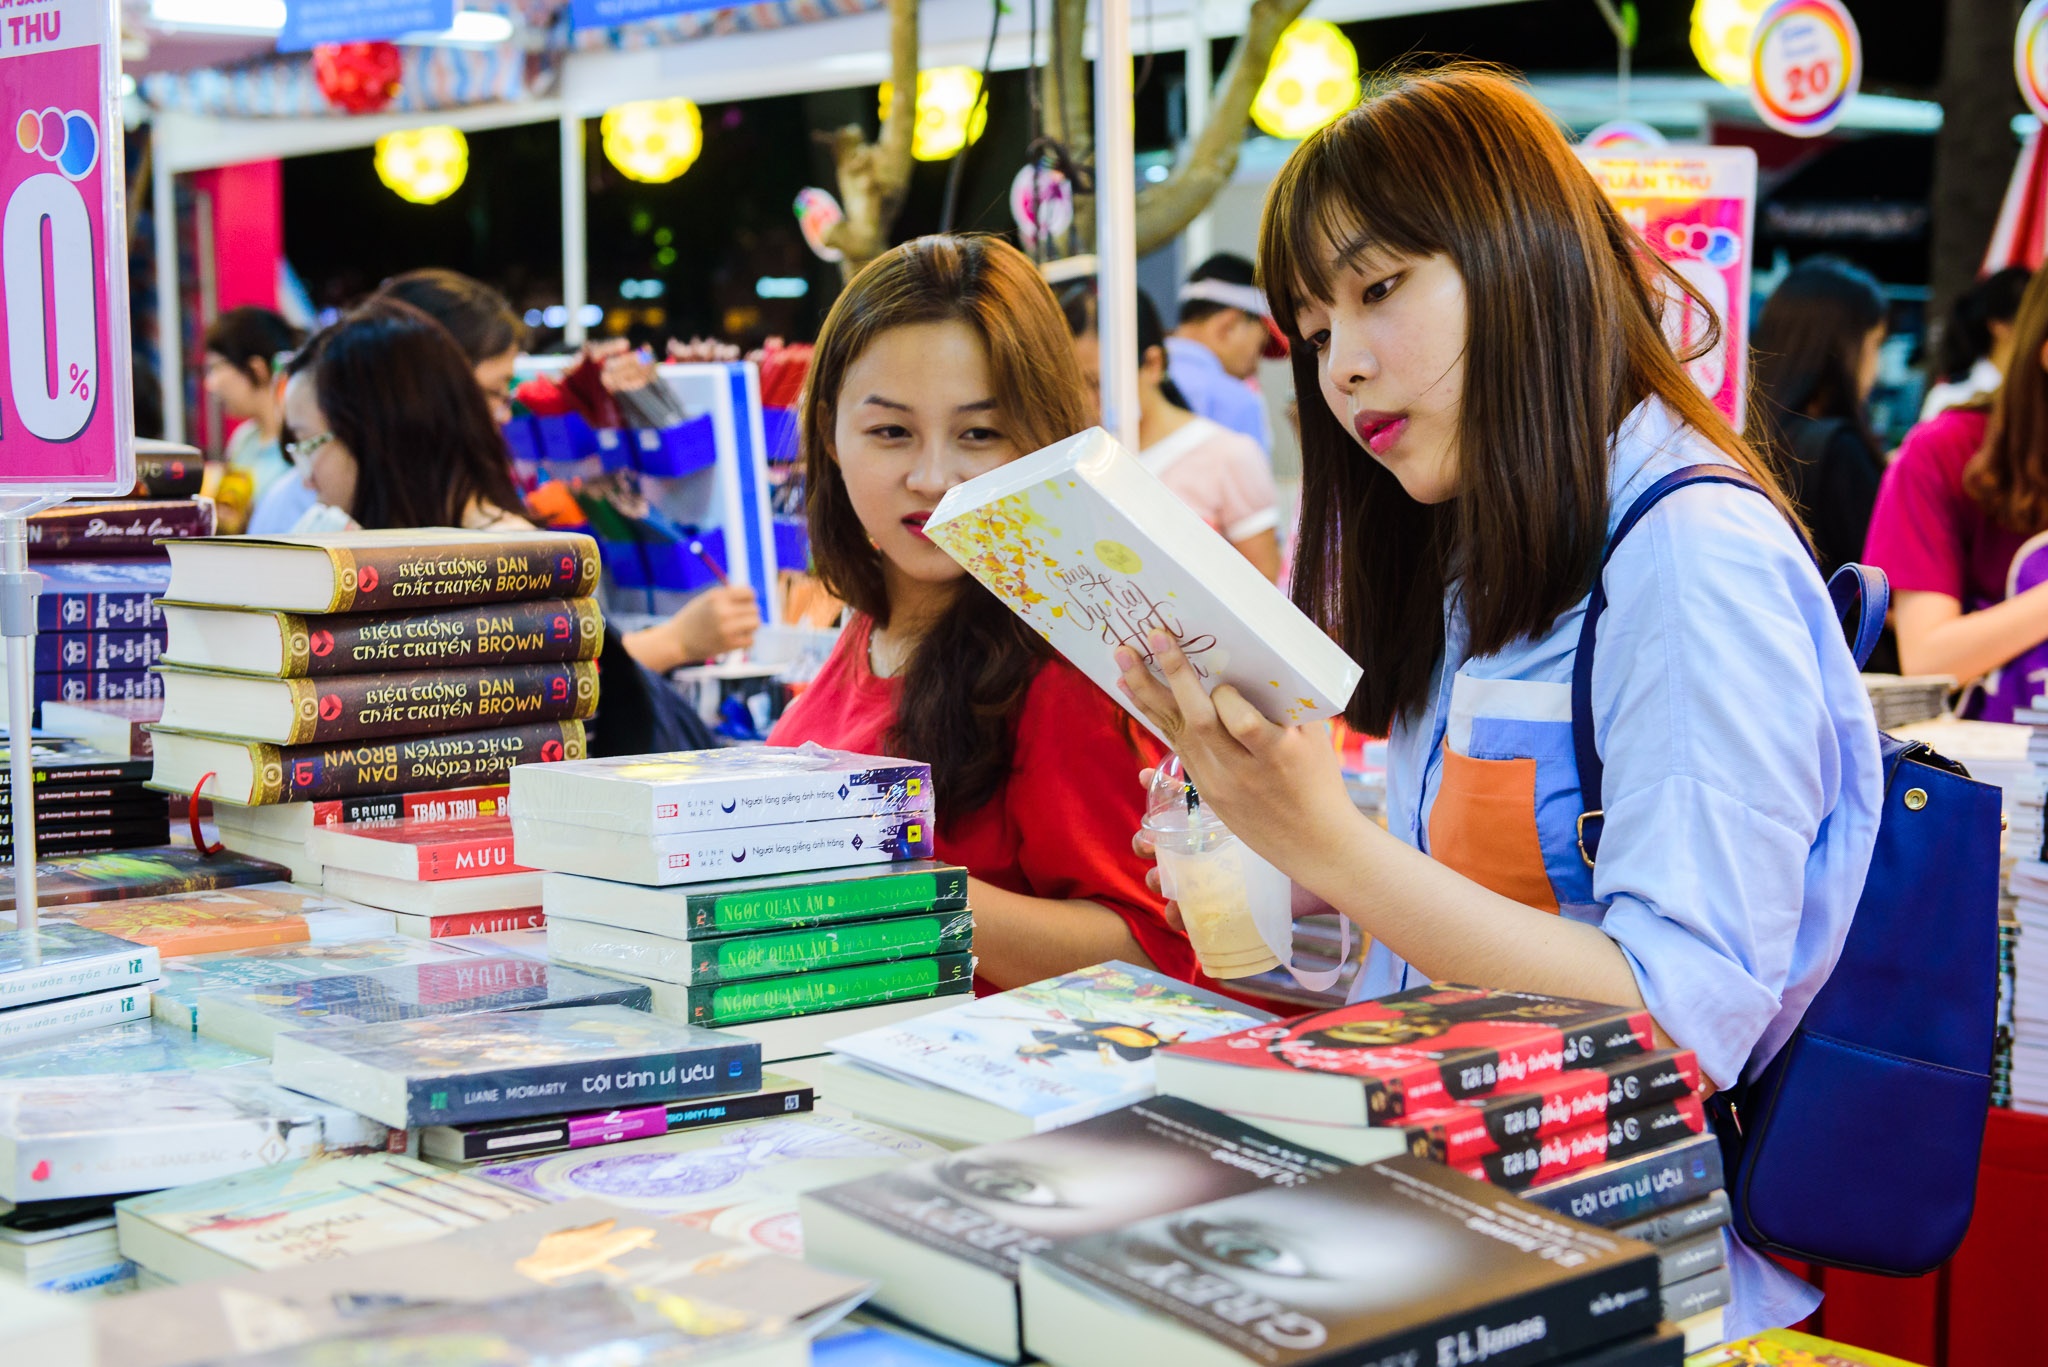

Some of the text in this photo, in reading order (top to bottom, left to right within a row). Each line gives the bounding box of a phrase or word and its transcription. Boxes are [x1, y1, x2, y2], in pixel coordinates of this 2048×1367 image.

[8, 10, 60, 46] THU
[0, 172, 98, 442] 0
[496, 557, 529, 573] DAN
[495, 573, 551, 592] BROWN
[476, 616, 514, 636] DAN
[477, 633, 544, 653] BROWN
[479, 677, 514, 697] DAN
[478, 694, 542, 715] BROWN
[324, 745, 398, 768] BROWN
[357, 765, 398, 784] DAN
[351, 803, 397, 818] BRUNO
[455, 846, 506, 869] MƯU
[765, 897, 801, 919] QUAN
[769, 943, 805, 962] QUAN
[764, 986, 801, 1009] QUAN
[0, 1021, 21, 1034] hu
[465, 1081, 567, 1105] LIANE MORIARTY
[1127, 1259, 1328, 1351] GREY
